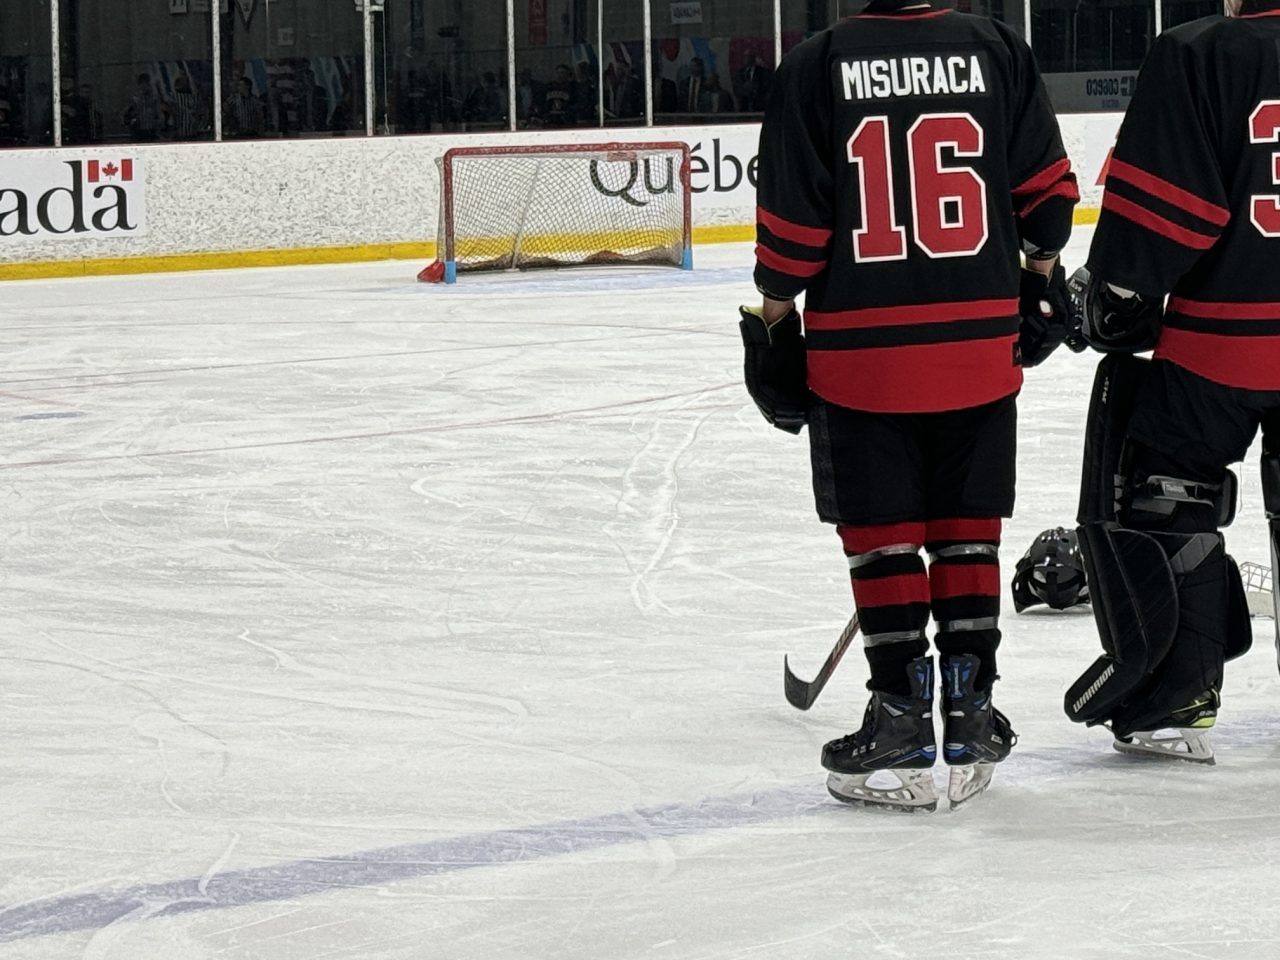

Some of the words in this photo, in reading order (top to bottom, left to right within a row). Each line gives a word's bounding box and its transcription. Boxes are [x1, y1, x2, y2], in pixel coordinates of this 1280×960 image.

[841, 54, 986, 101] MISURACA
[846, 111, 989, 263] 16
[1072, 663, 1115, 714] WARRIOR
